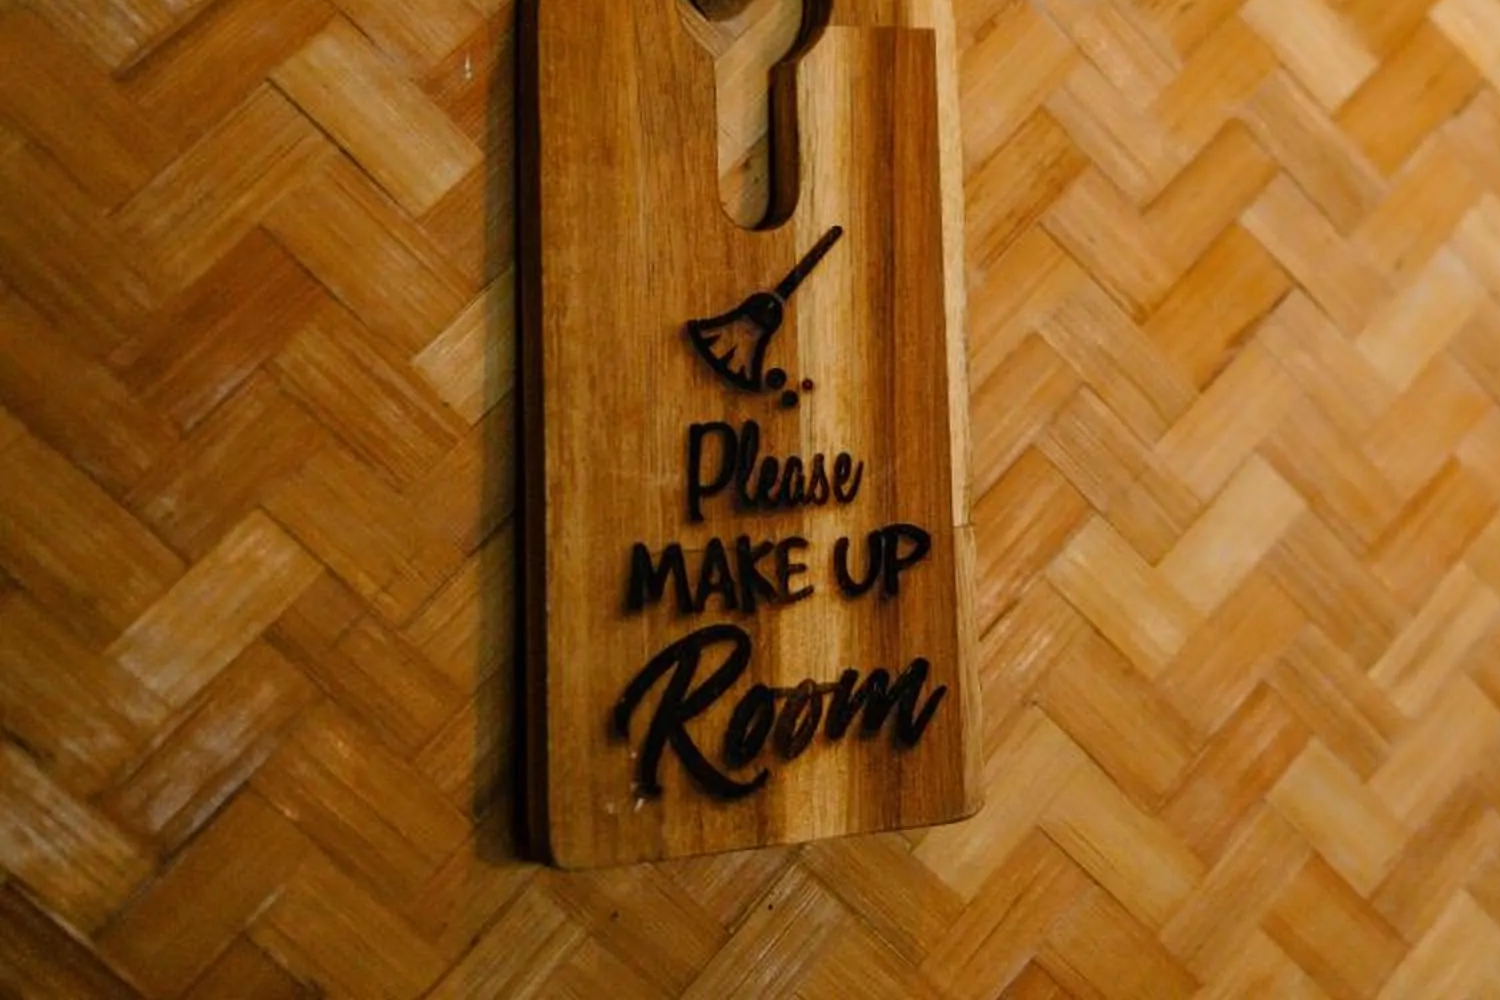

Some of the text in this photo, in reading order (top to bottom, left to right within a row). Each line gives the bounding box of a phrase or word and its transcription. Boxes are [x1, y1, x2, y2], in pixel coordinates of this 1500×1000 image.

[686, 419, 864, 523] Please
[624, 523, 931, 616] MAKE UP
[611, 623, 947, 801] Room
